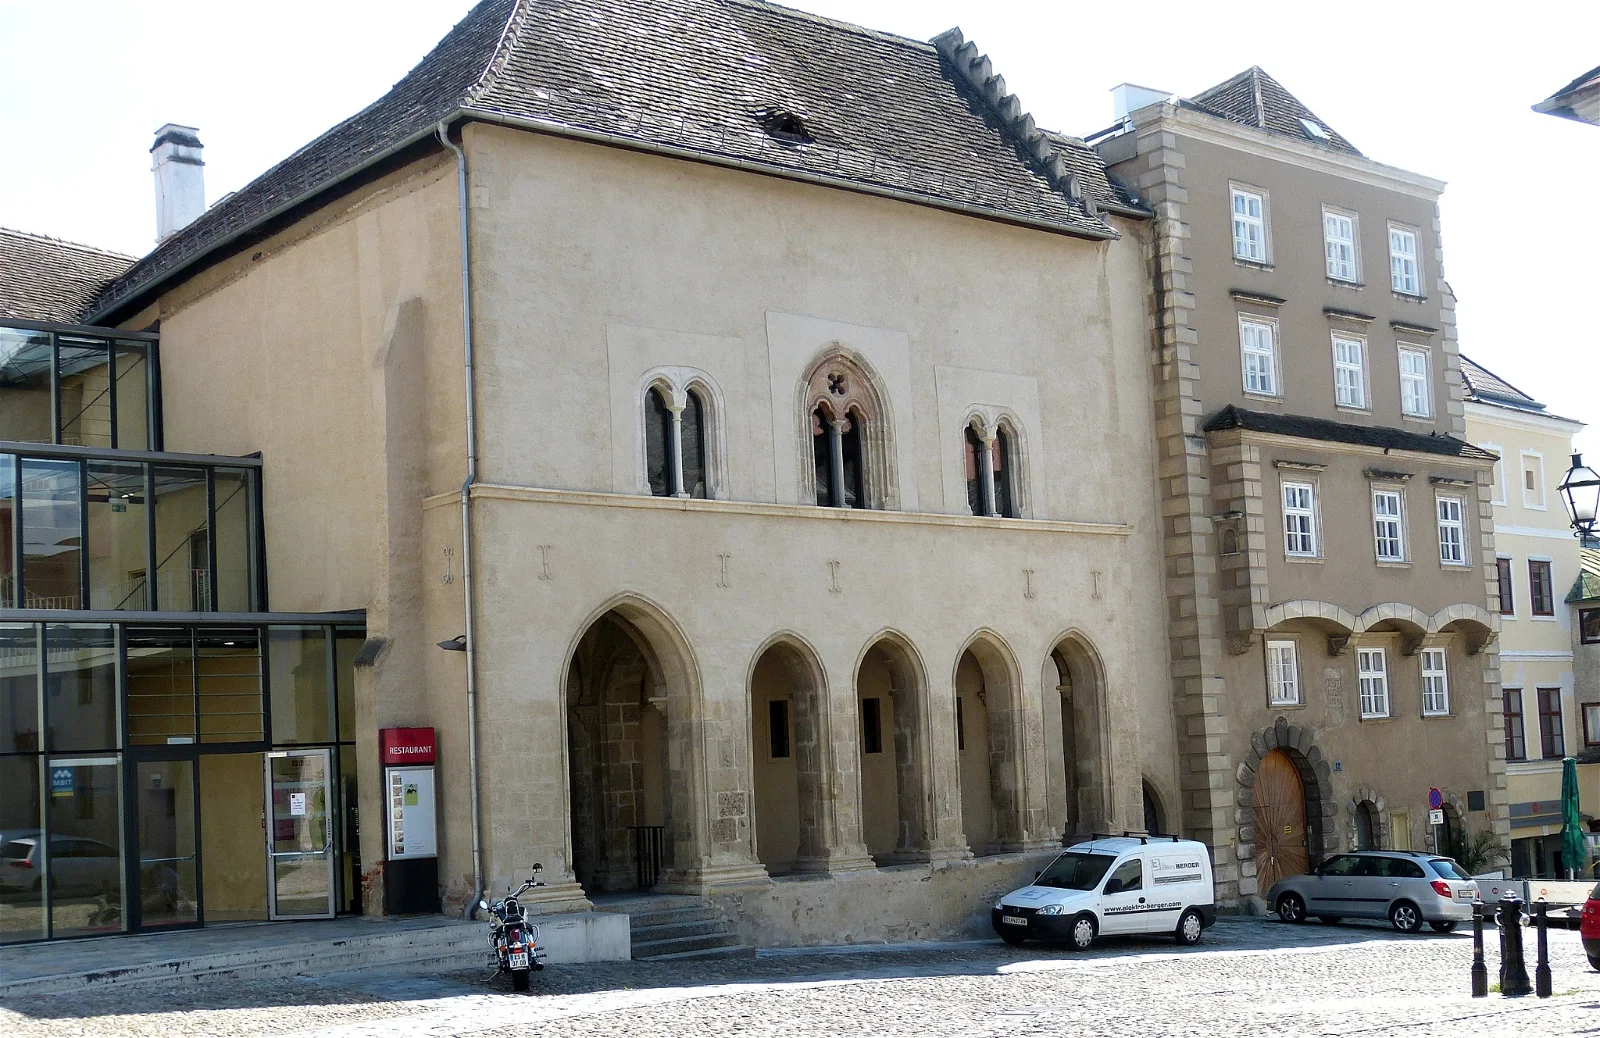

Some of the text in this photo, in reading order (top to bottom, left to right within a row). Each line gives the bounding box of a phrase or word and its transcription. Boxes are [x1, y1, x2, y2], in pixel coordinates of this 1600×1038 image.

[389, 745, 432, 755] RESTAURANT
[1175, 861, 1200, 870] BERGER
[1104, 901, 1182, 912] www.elektro-berger.com
